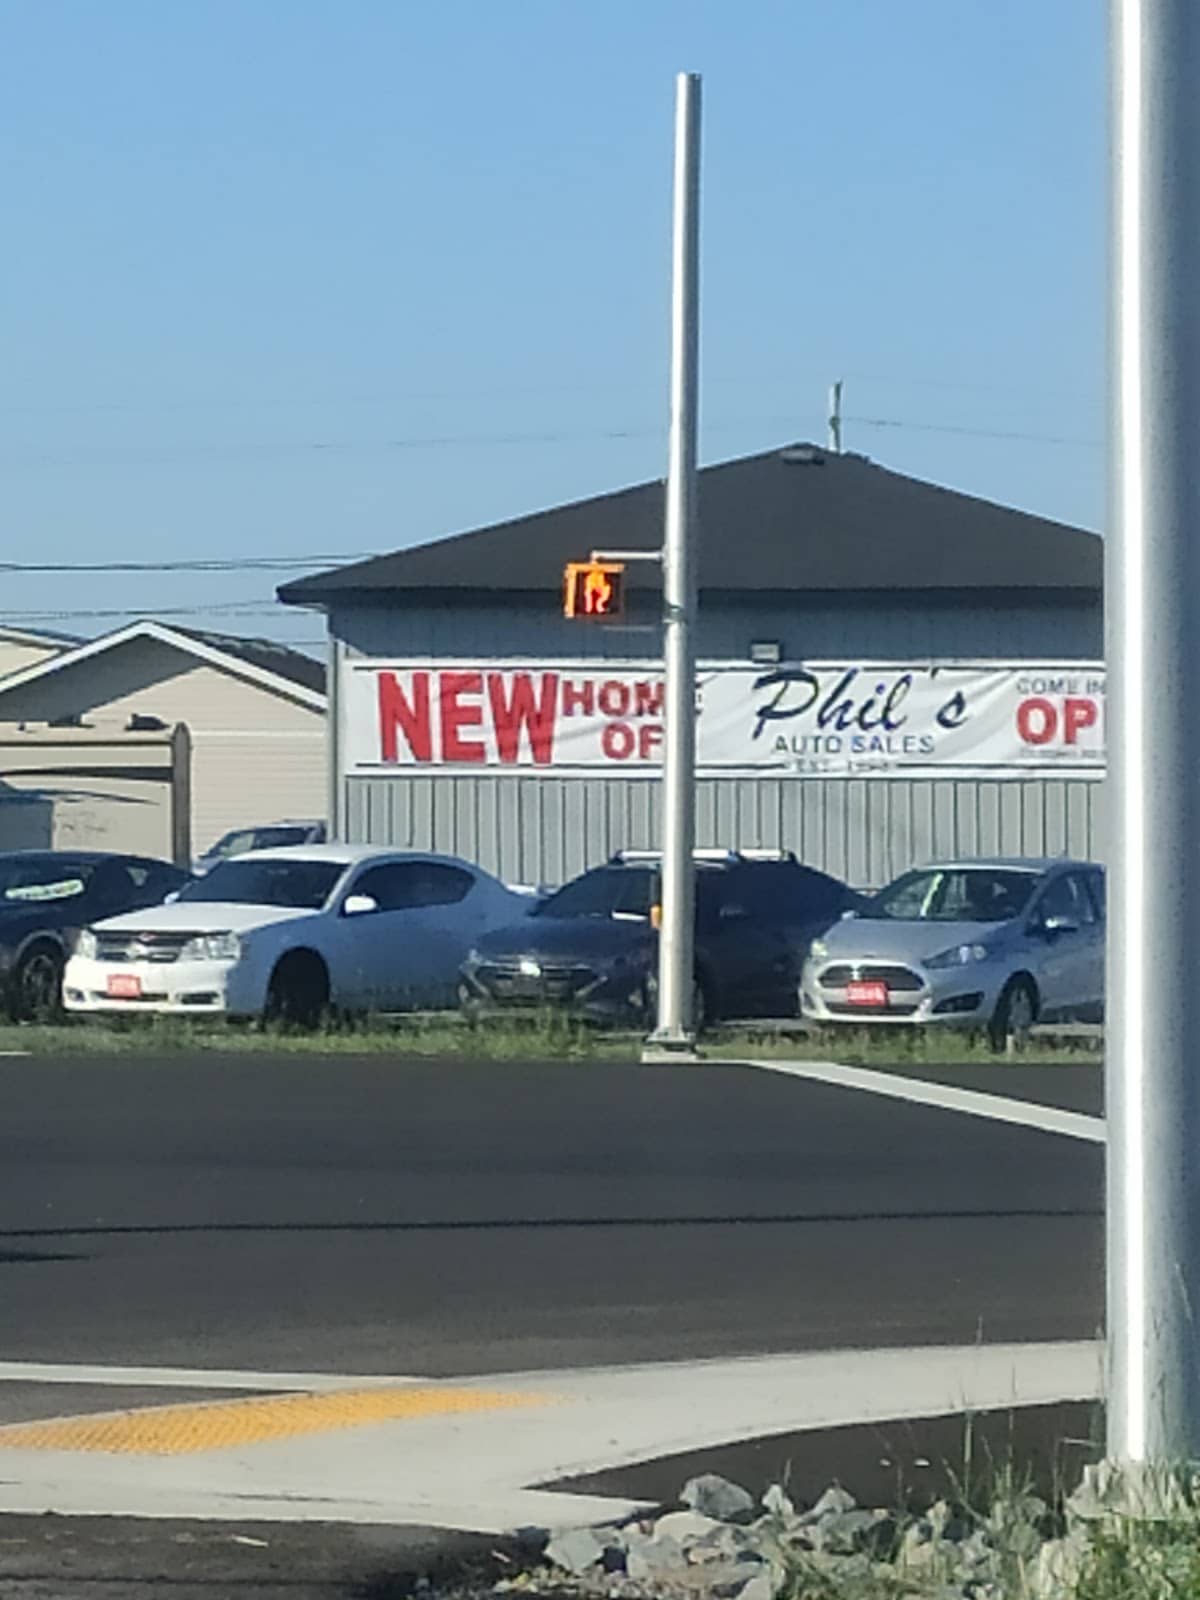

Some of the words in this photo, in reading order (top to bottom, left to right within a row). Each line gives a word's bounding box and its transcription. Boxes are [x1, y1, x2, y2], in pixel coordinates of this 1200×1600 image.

[562, 681, 702, 717] HOM
[752, 667, 969, 740] Phil's
[1016, 677, 1077, 695] COME
[378, 671, 559, 764] NEW
[1016, 697, 1104, 744] OP
[602, 724, 664, 759] OF
[773, 734, 843, 754] AUTO
[851, 734, 935, 754] SALES
